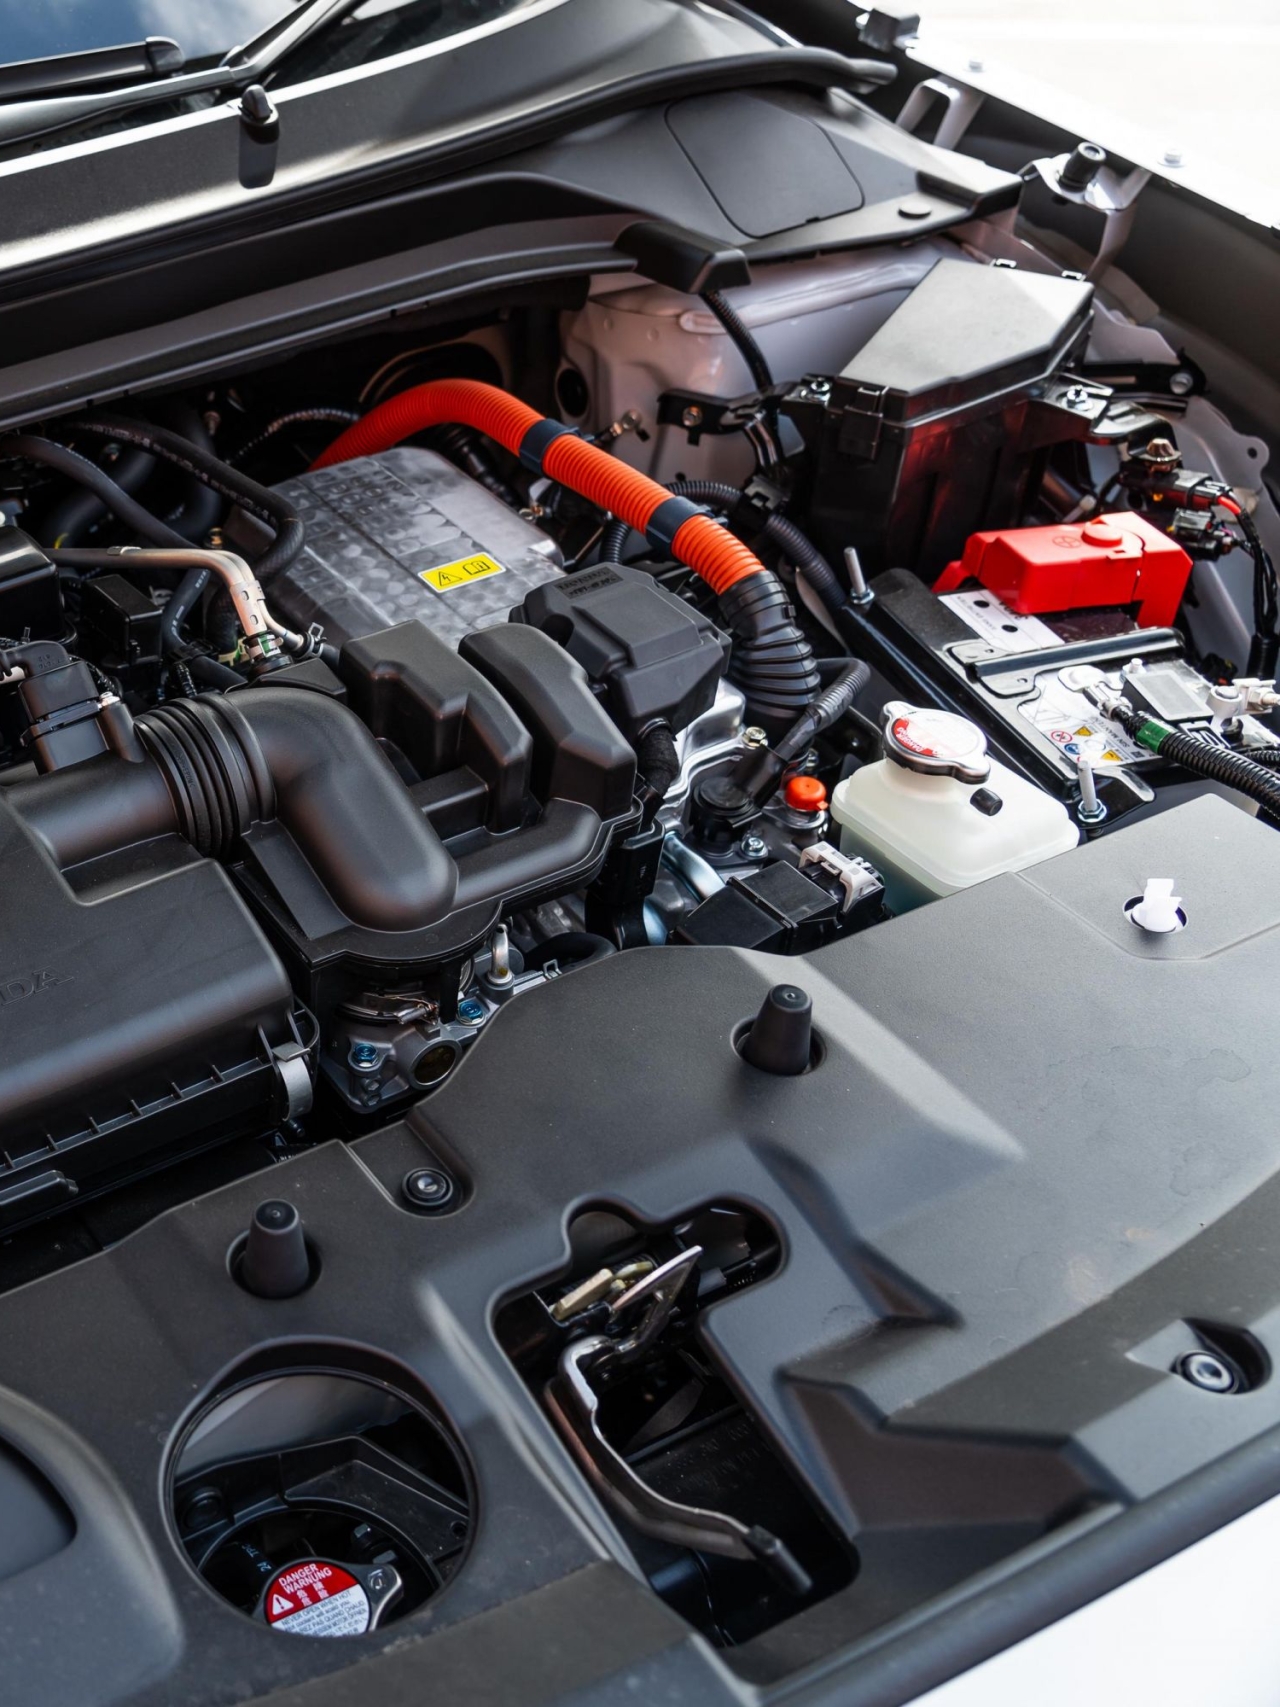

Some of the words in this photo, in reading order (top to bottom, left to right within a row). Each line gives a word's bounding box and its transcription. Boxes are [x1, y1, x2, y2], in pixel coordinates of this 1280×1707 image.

[278, 1563, 319, 1586] DANGER
[284, 1567, 332, 1595] WARNUNG
[281, 1612, 302, 1625] NEVER
[302, 1605, 320, 1616] OPEN
[319, 1597, 339, 1608] WHEN
[339, 1590, 351, 1600] HOT
[324, 1610, 344, 1621] QUAND
